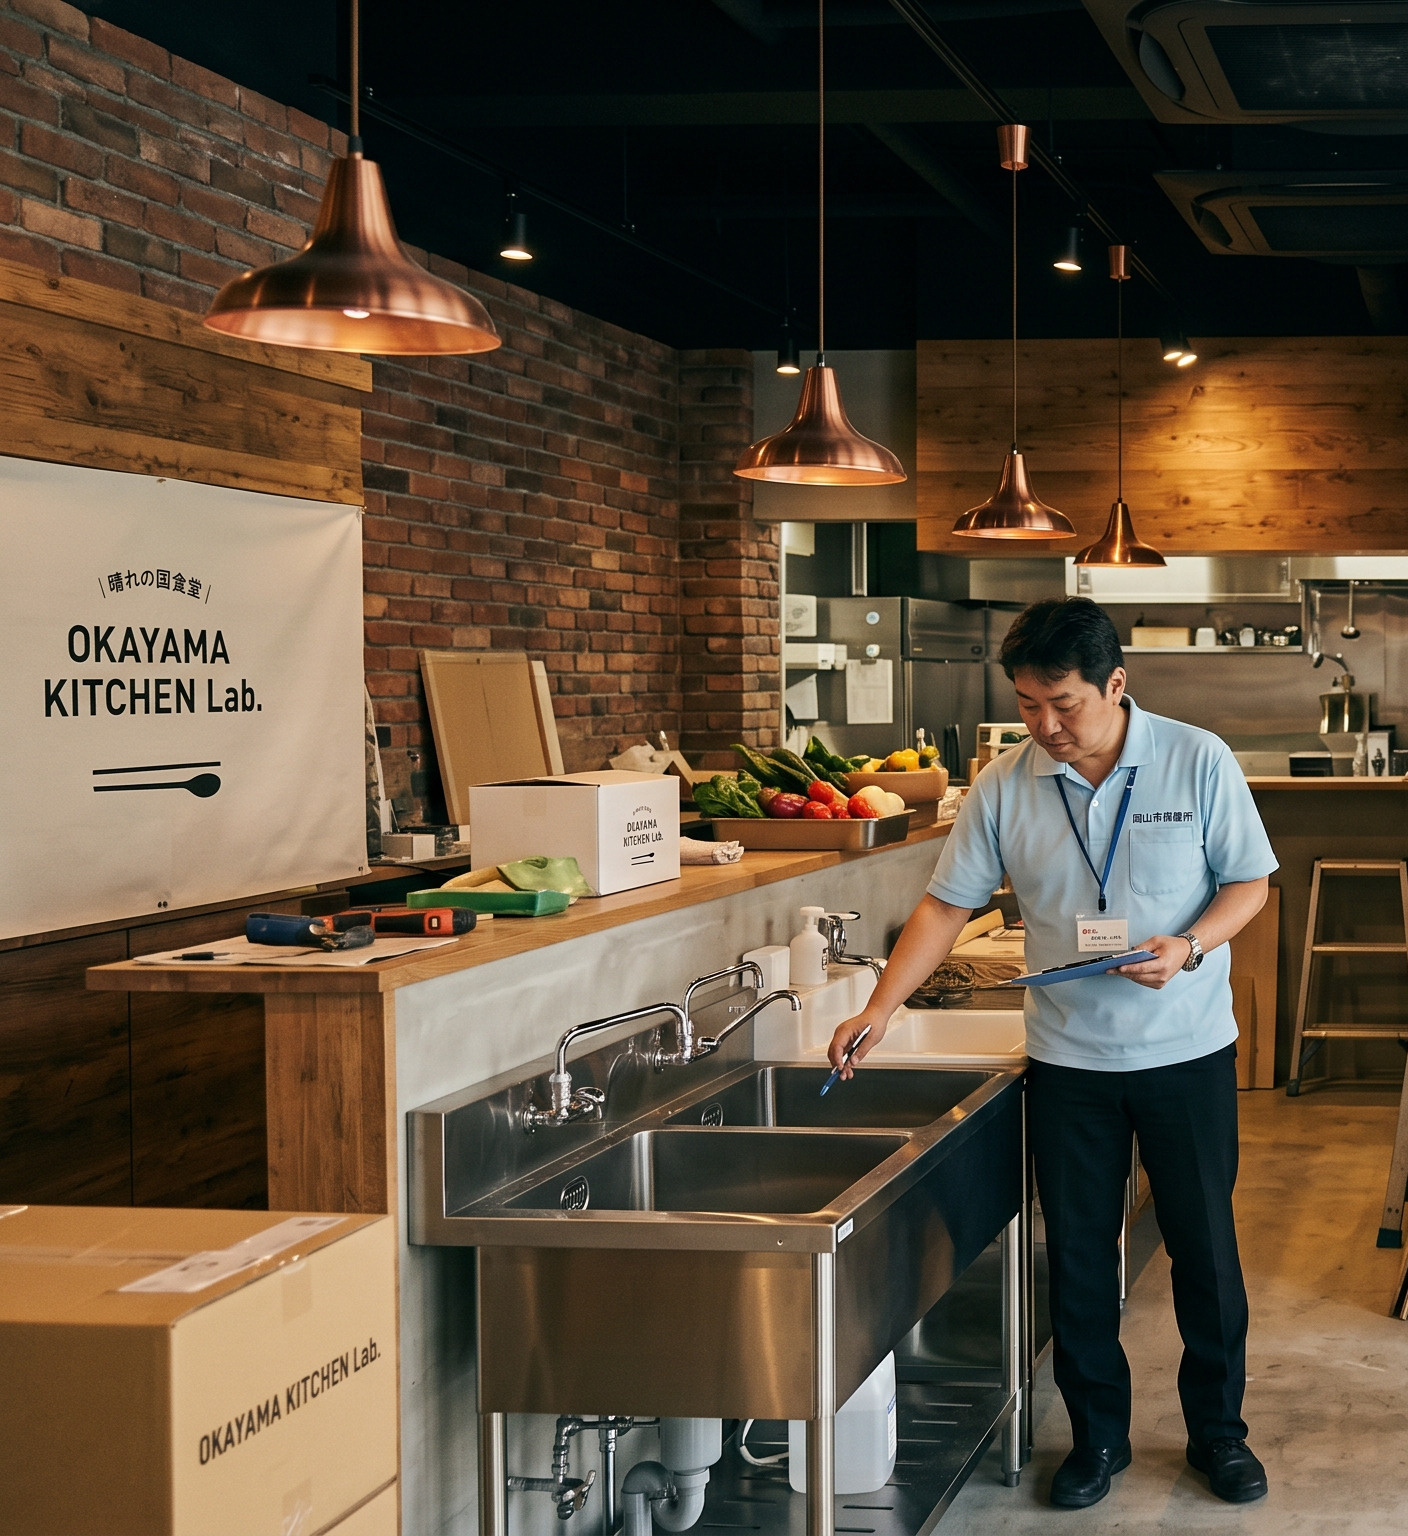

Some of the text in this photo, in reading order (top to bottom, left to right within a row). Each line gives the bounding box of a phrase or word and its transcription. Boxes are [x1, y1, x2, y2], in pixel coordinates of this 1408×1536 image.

[107, 568, 202, 600] 晴れの国食堂
[67, 624, 231, 665] OKAYAMA
[44, 678, 263, 718] KITCHEN Lab.
[198, 1337, 381, 1466] OKAYAMA KITCHEN Lab.
